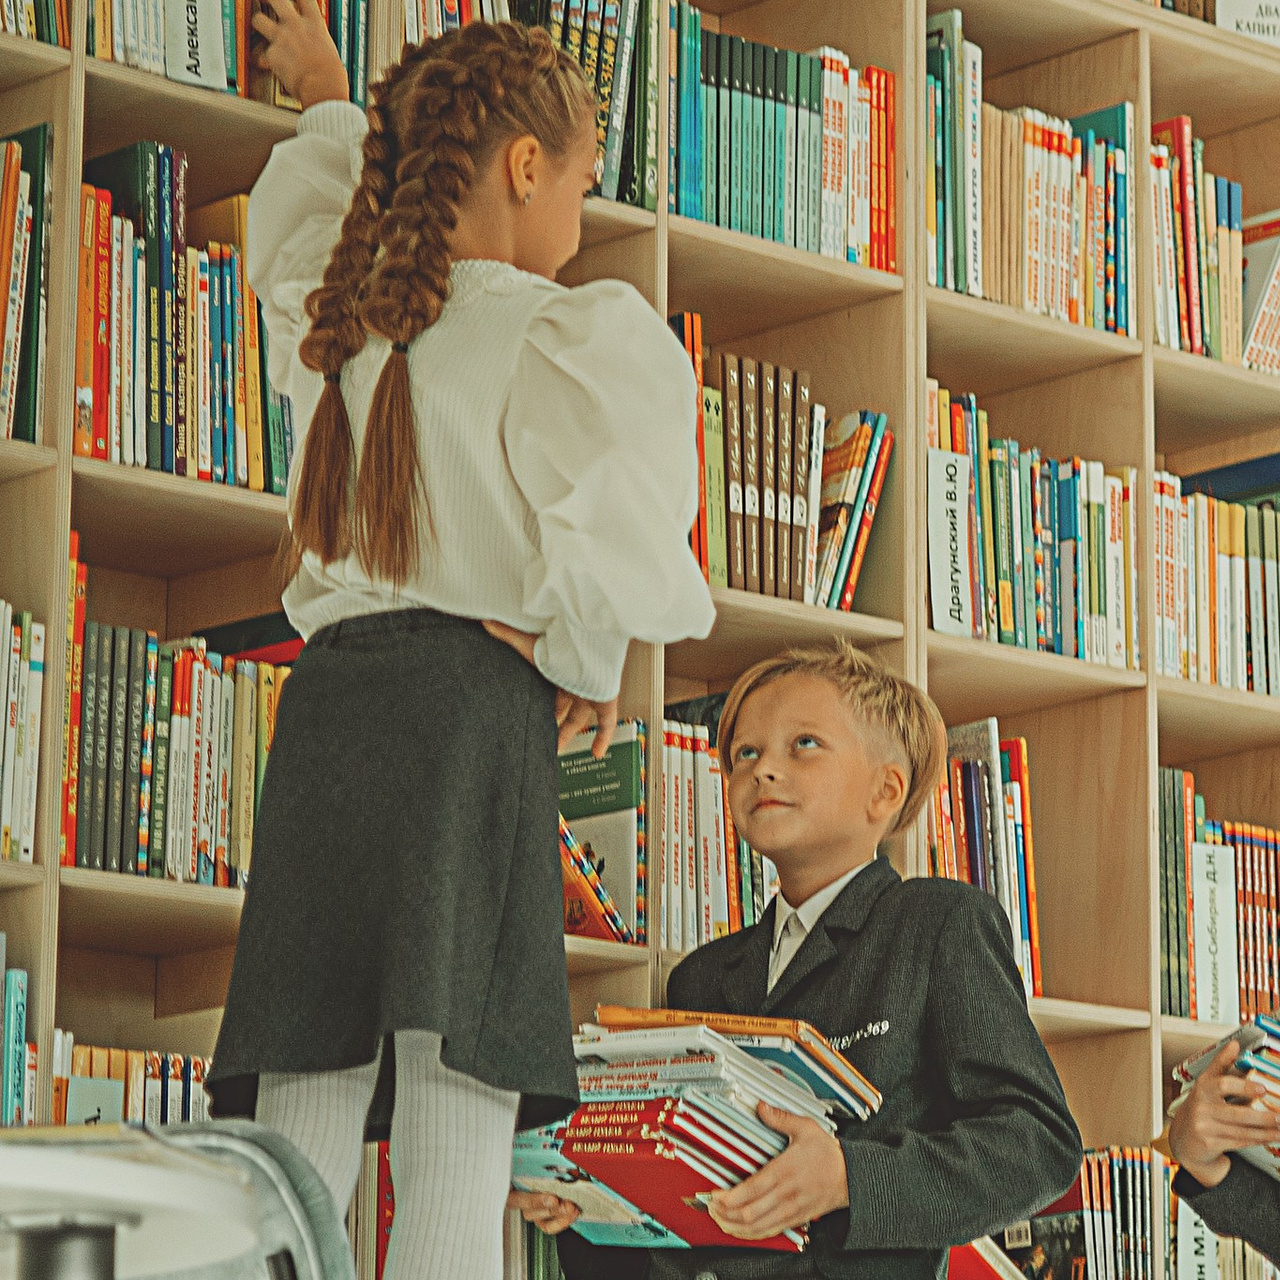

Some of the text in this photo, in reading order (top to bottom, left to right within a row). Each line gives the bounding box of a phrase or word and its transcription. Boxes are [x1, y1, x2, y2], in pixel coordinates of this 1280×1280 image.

[1255, 3, 1280, 19] ДВА
[969, 59, 980, 286] АГНИЯ БАРТО СТИХИ ДЕТЯМ
[96, 200, 110, 315] КАРУСЕЛЬ В ГОЛОВЕ
[1093, 184, 1105, 292] АГНИЯ БАРТО
[175, 362, 187, 417] мастера
[175, 423, 188, 458] Тайна
[944, 457, 964, 624] Драгунский В.Ю.
[72, 643, 83, 693] БАСНИ
[1205, 849, 1220, 1021] Мамин-Сибиряк Д.Н.
